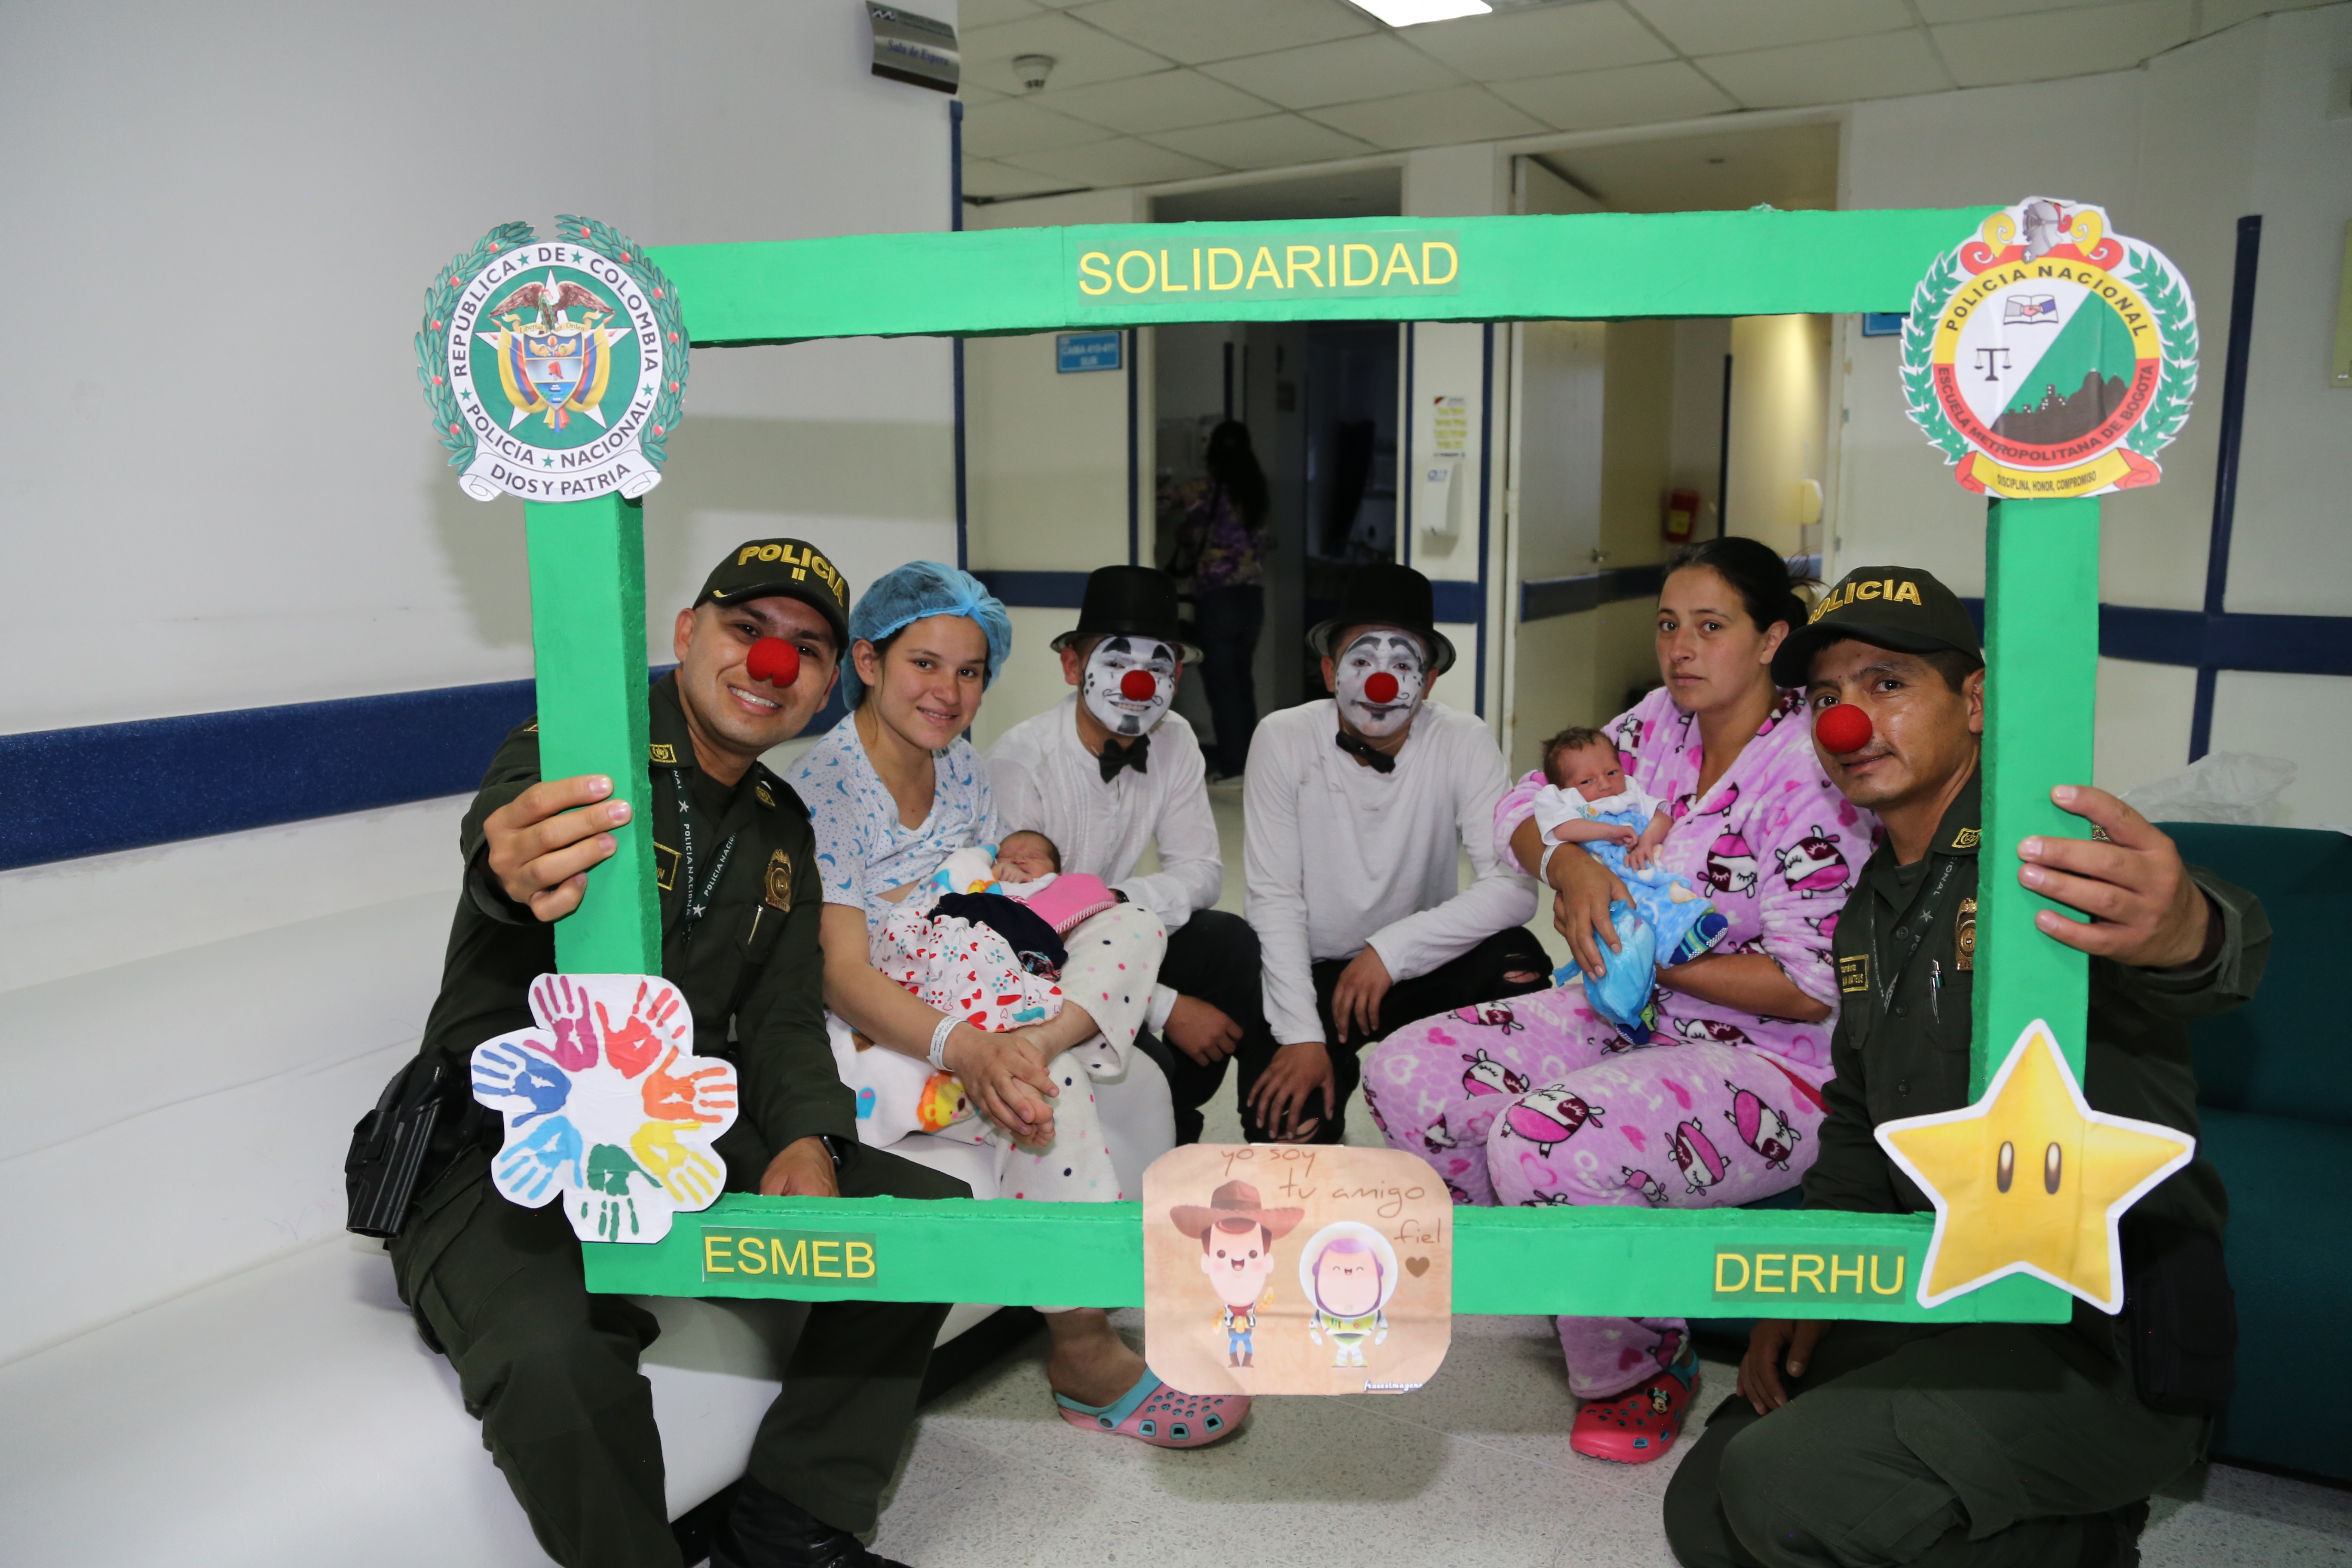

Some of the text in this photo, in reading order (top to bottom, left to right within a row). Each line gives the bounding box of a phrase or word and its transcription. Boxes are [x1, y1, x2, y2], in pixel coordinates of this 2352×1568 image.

[1078, 242, 1458, 295] SOLIDARIDAD
[451, 247, 658, 377] REPÚBLICA DE COLOMBIA
[1946, 265, 2149, 337] POLICIA NACIONAL
[520, 325, 543, 333] Libertad
[566, 322, 585, 331] Orden
[466, 398, 652, 469] POLICÍA NACIONAL
[1938, 365, 2153, 461] ESCUELA METROPOLITANA DE BOGOTA
[490, 463, 631, 496] DIOS Y PATRIA
[1997, 471, 2097, 492] DISCIPLINA, HONOR, COMPROMISO
[738, 544, 845, 607] POLICIA
[683, 823, 694, 919] POLICIA NACIONA
[703, 863, 723, 897] POLICIA
[1933, 857, 1957, 895] IONAL
[1221, 1148, 1316, 1177] yo soy
[1332, 1181, 1425, 1219] amigo
[1394, 1218, 1441, 1244] fiel
[704, 1236, 876, 1279] ESMEB
[1715, 1253, 1905, 1295] DERHU
